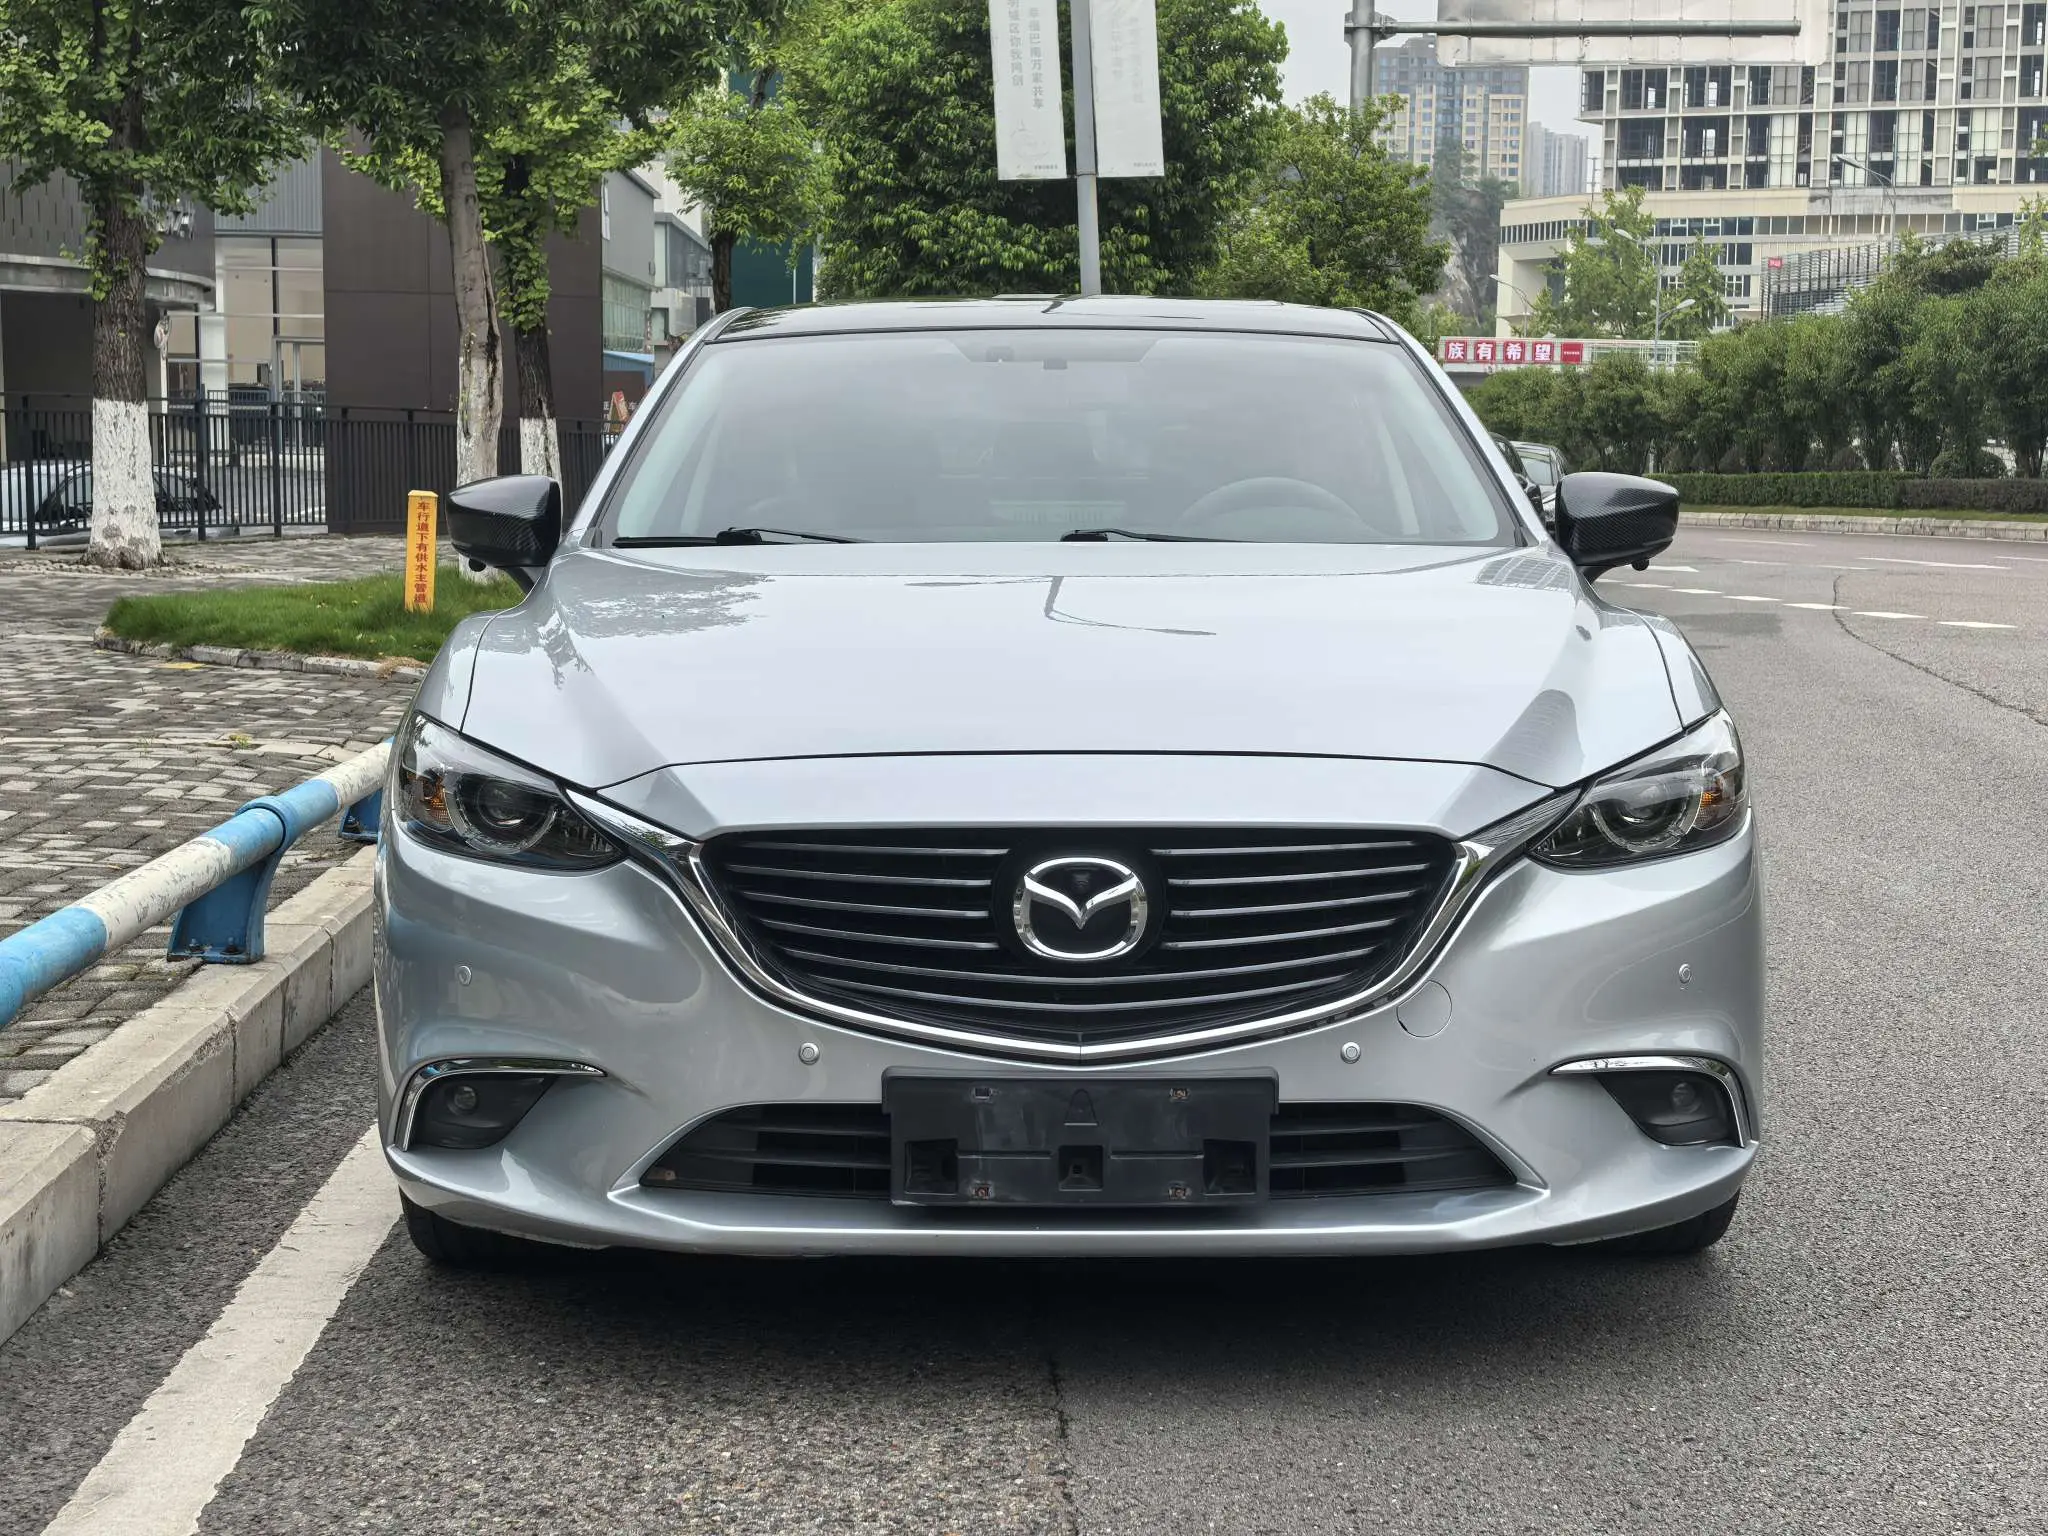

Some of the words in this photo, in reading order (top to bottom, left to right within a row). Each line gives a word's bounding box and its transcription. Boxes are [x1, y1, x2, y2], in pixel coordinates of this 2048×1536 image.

[1448, 342, 1551, 361] 族有希望
[414, 501, 430, 604] 车行道下有供水主管道
